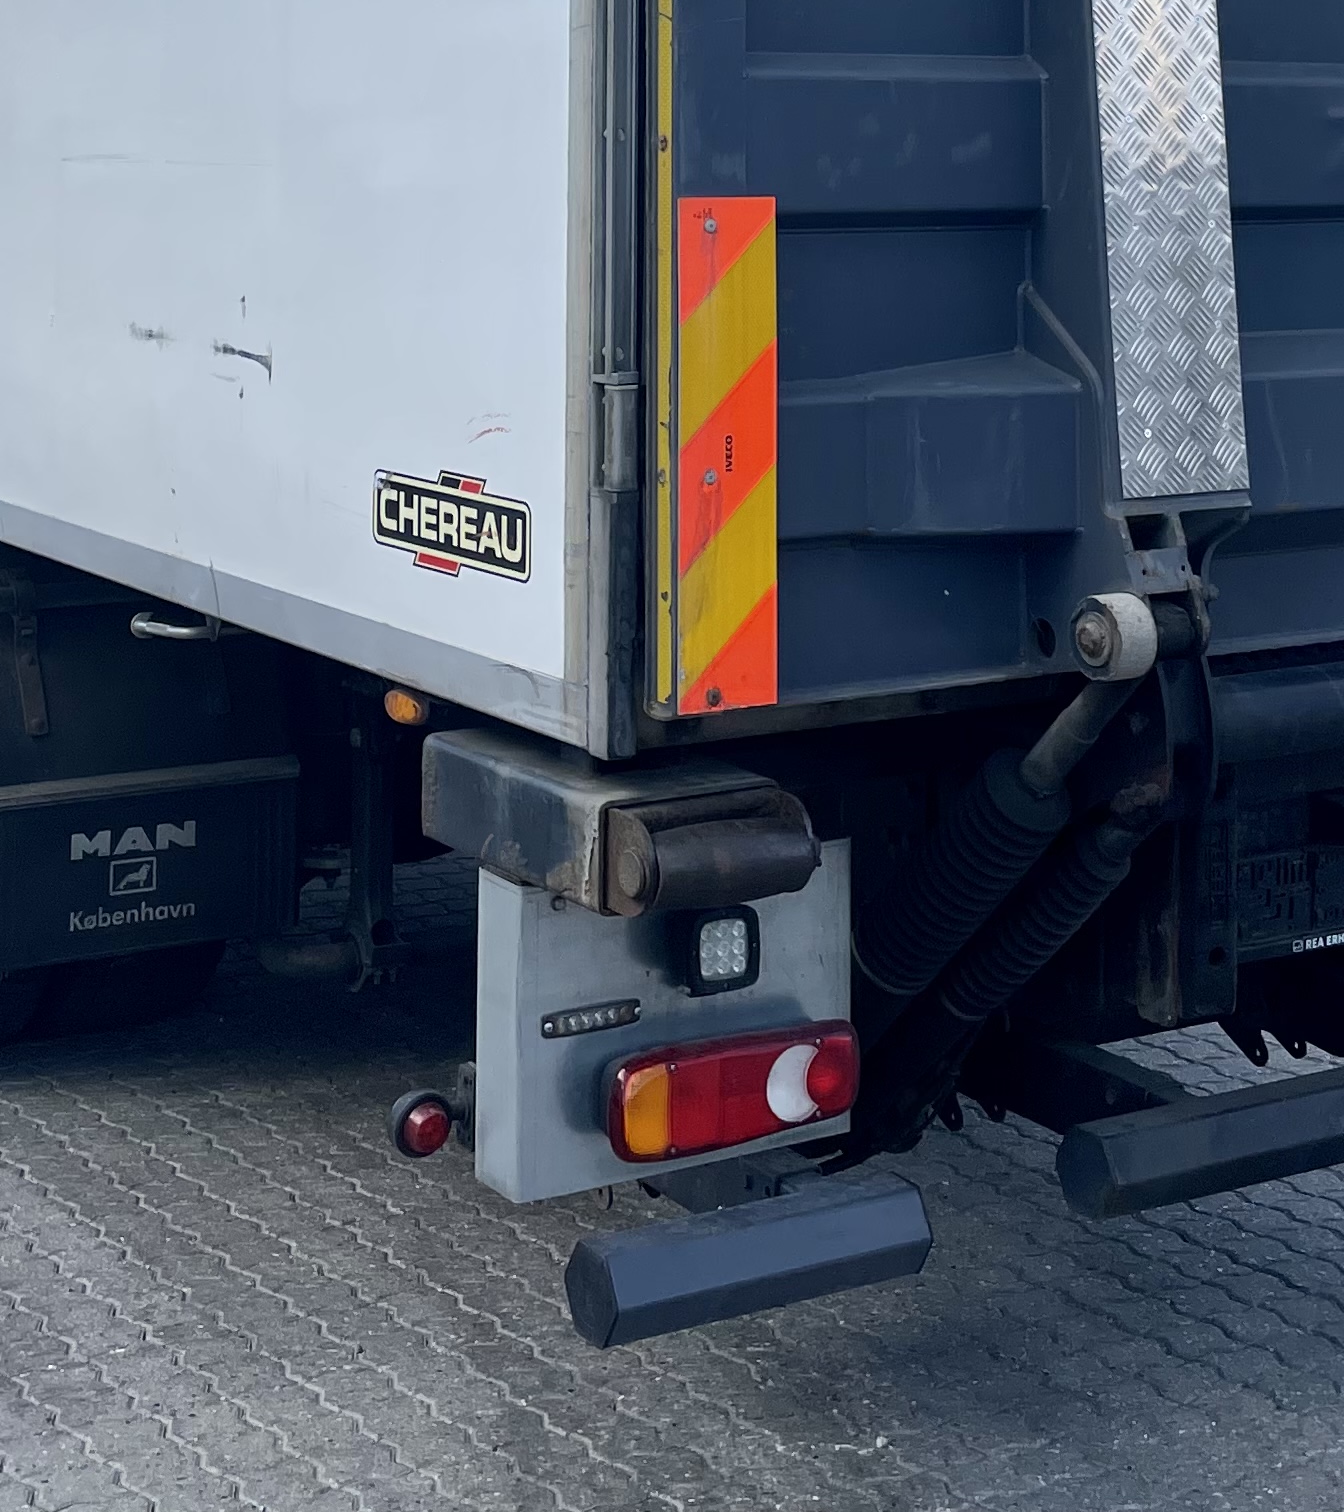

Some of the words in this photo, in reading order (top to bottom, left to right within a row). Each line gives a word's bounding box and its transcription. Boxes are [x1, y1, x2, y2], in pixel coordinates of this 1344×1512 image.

[379, 488, 523, 563] CHEREAU
[70, 820, 197, 861] MAN
[69, 901, 196, 932] København
[1305, 936, 1325, 950] REA
